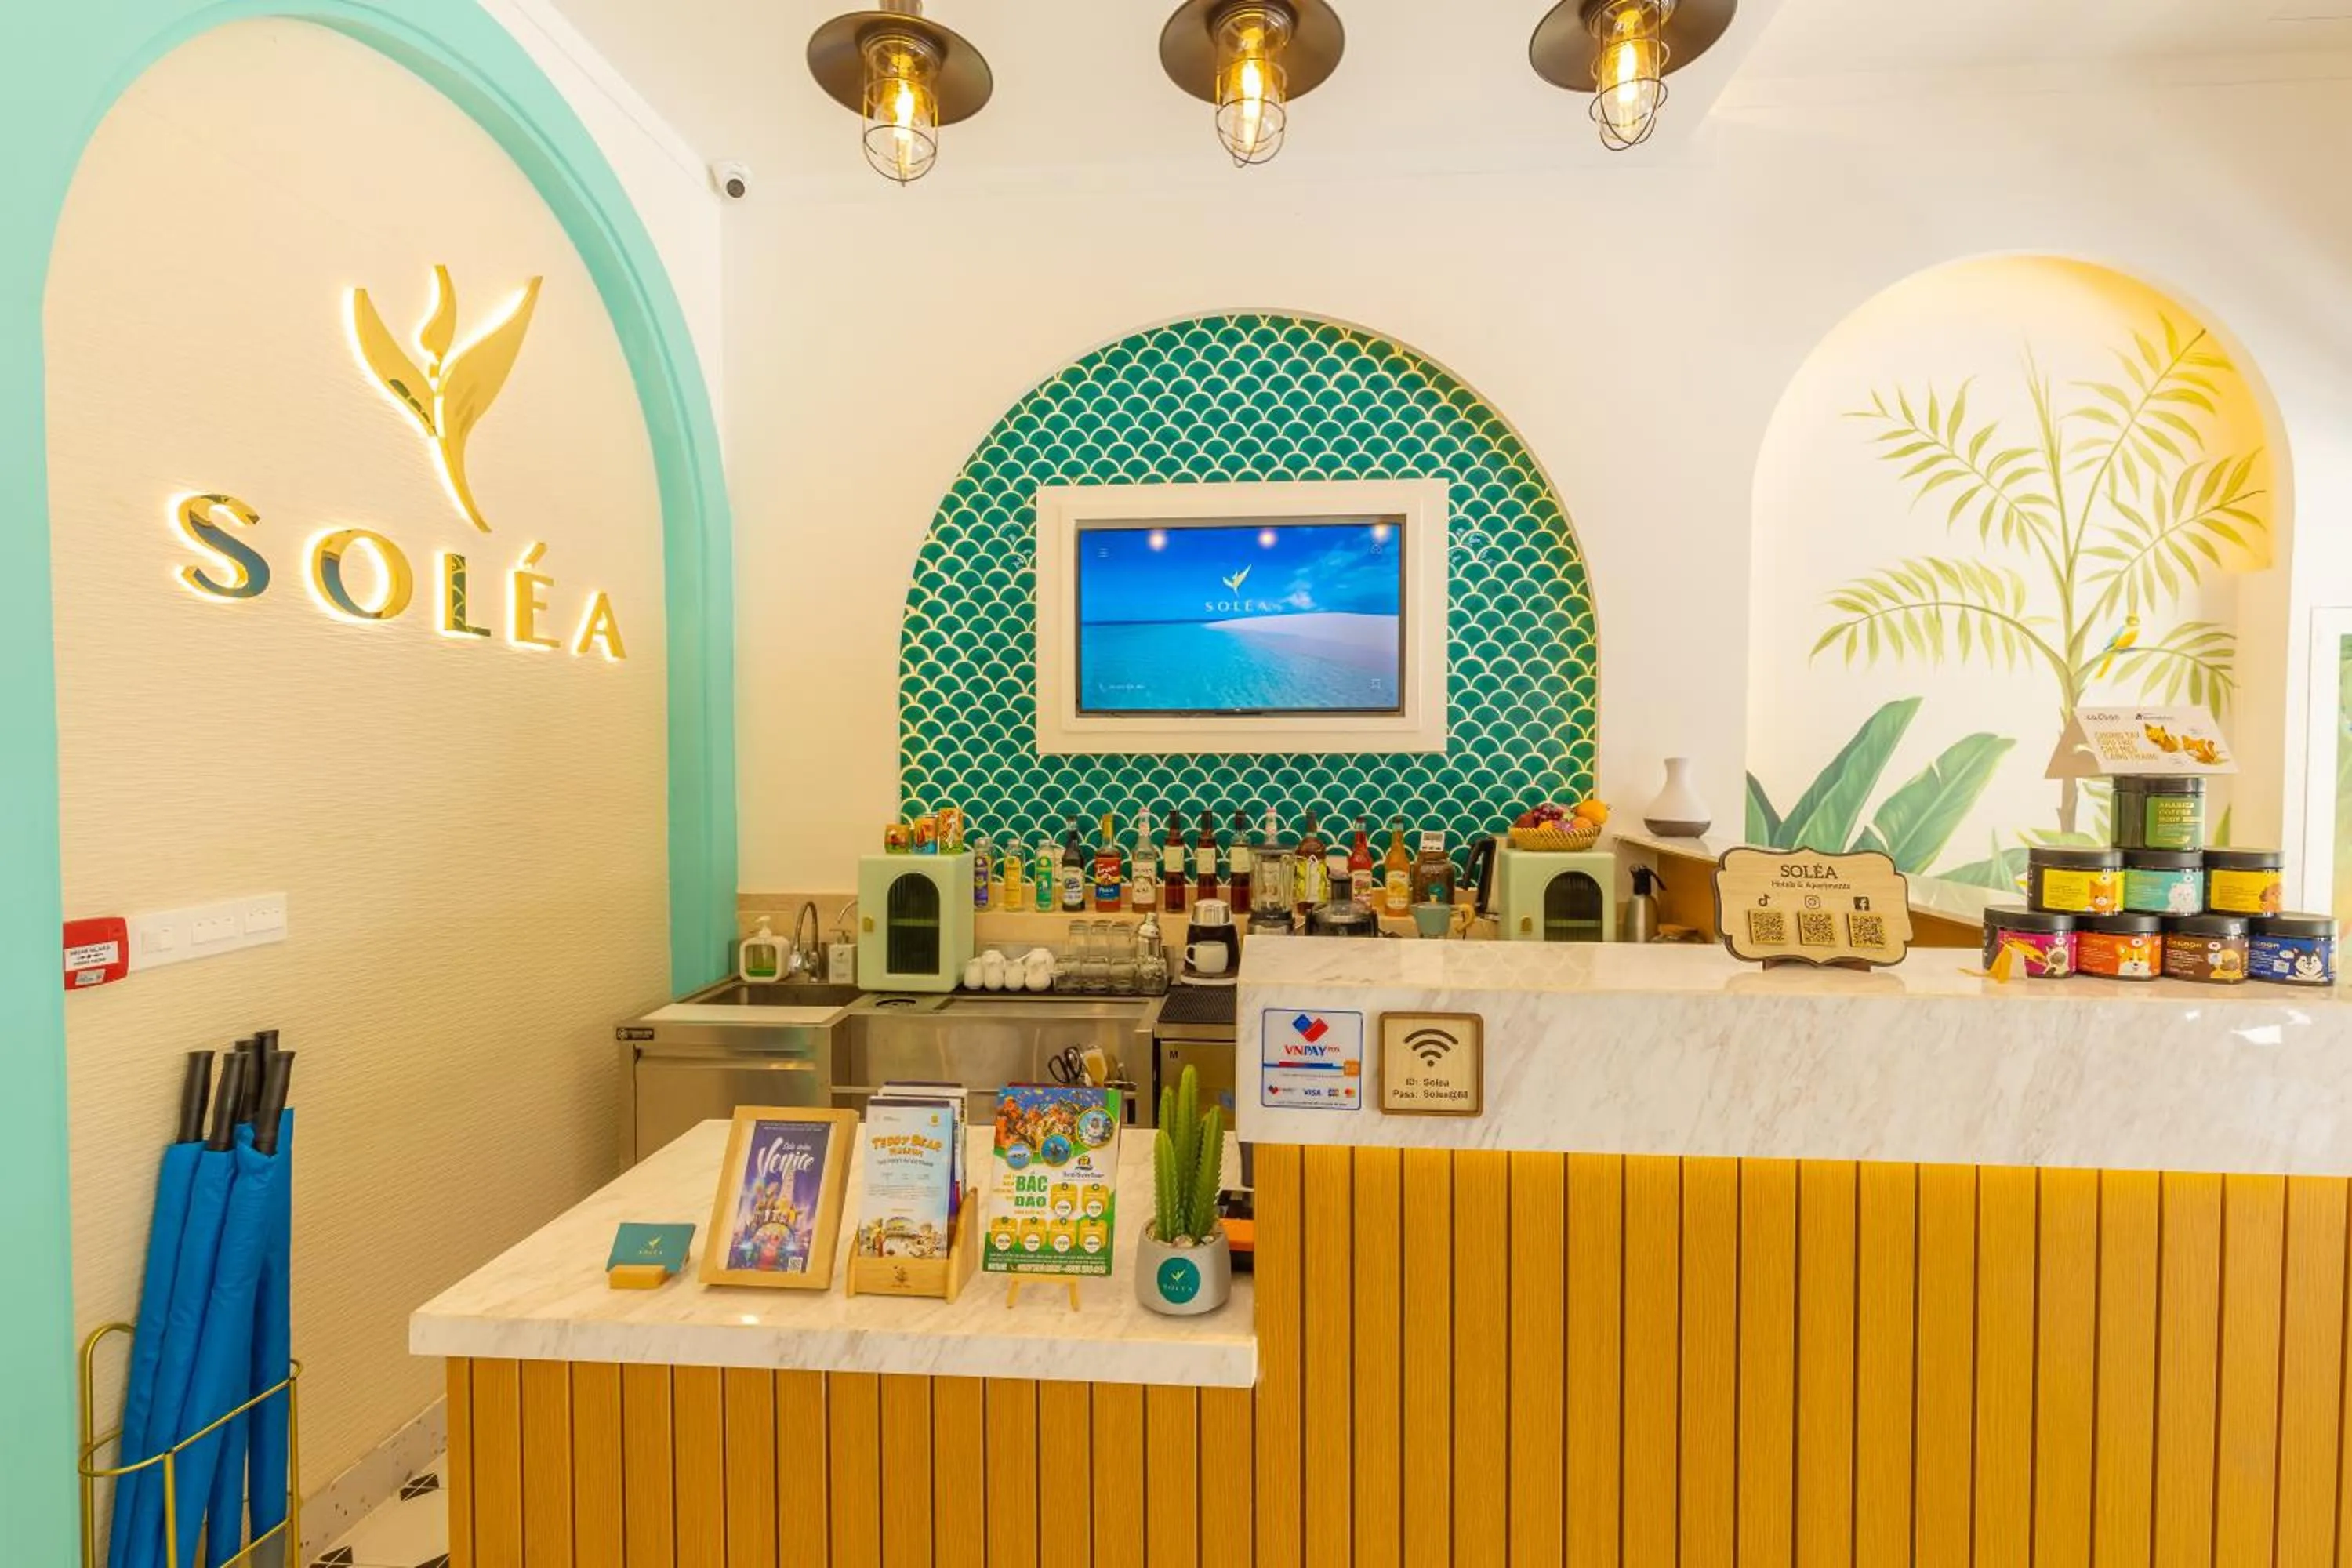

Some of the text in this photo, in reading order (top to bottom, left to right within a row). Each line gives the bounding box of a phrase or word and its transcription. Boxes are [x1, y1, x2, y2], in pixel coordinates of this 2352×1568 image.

[169, 492, 628, 660] SOLÉA
[1780, 863, 1838, 879] SOLÉA
[1284, 1044, 1327, 1056] VNPAY
